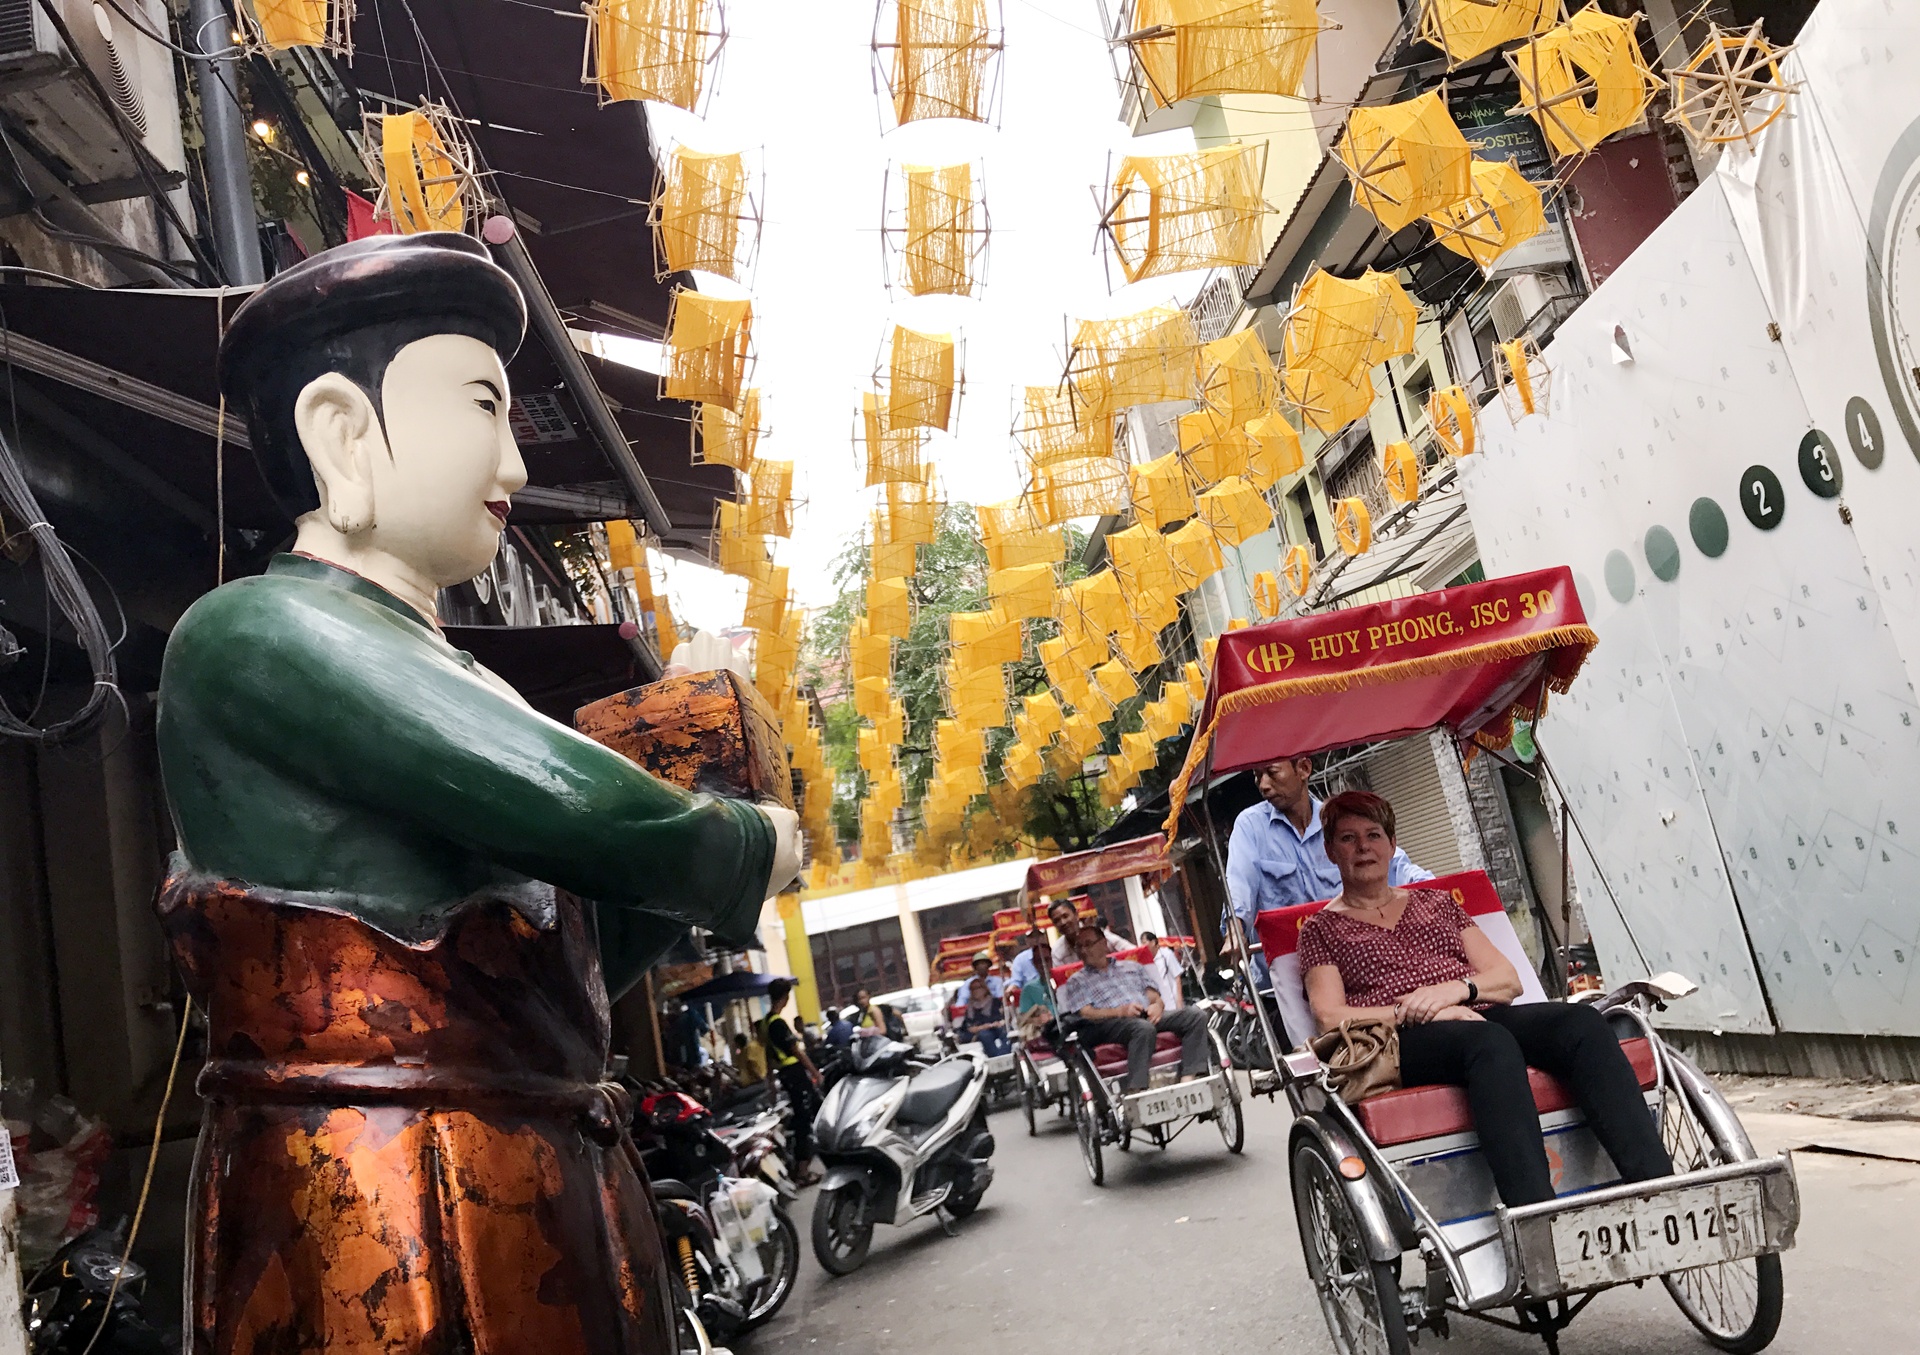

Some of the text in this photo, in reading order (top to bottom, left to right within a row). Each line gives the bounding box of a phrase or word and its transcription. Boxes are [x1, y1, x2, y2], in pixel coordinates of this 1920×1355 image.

[1857, 412, 1875, 451] 4
[1812, 443, 1834, 482] 3
[1752, 480, 1773, 516] 2
[1308, 632, 1361, 662] HUY
[1470, 597, 1511, 629] JSC
[1519, 589, 1557, 620] 30
